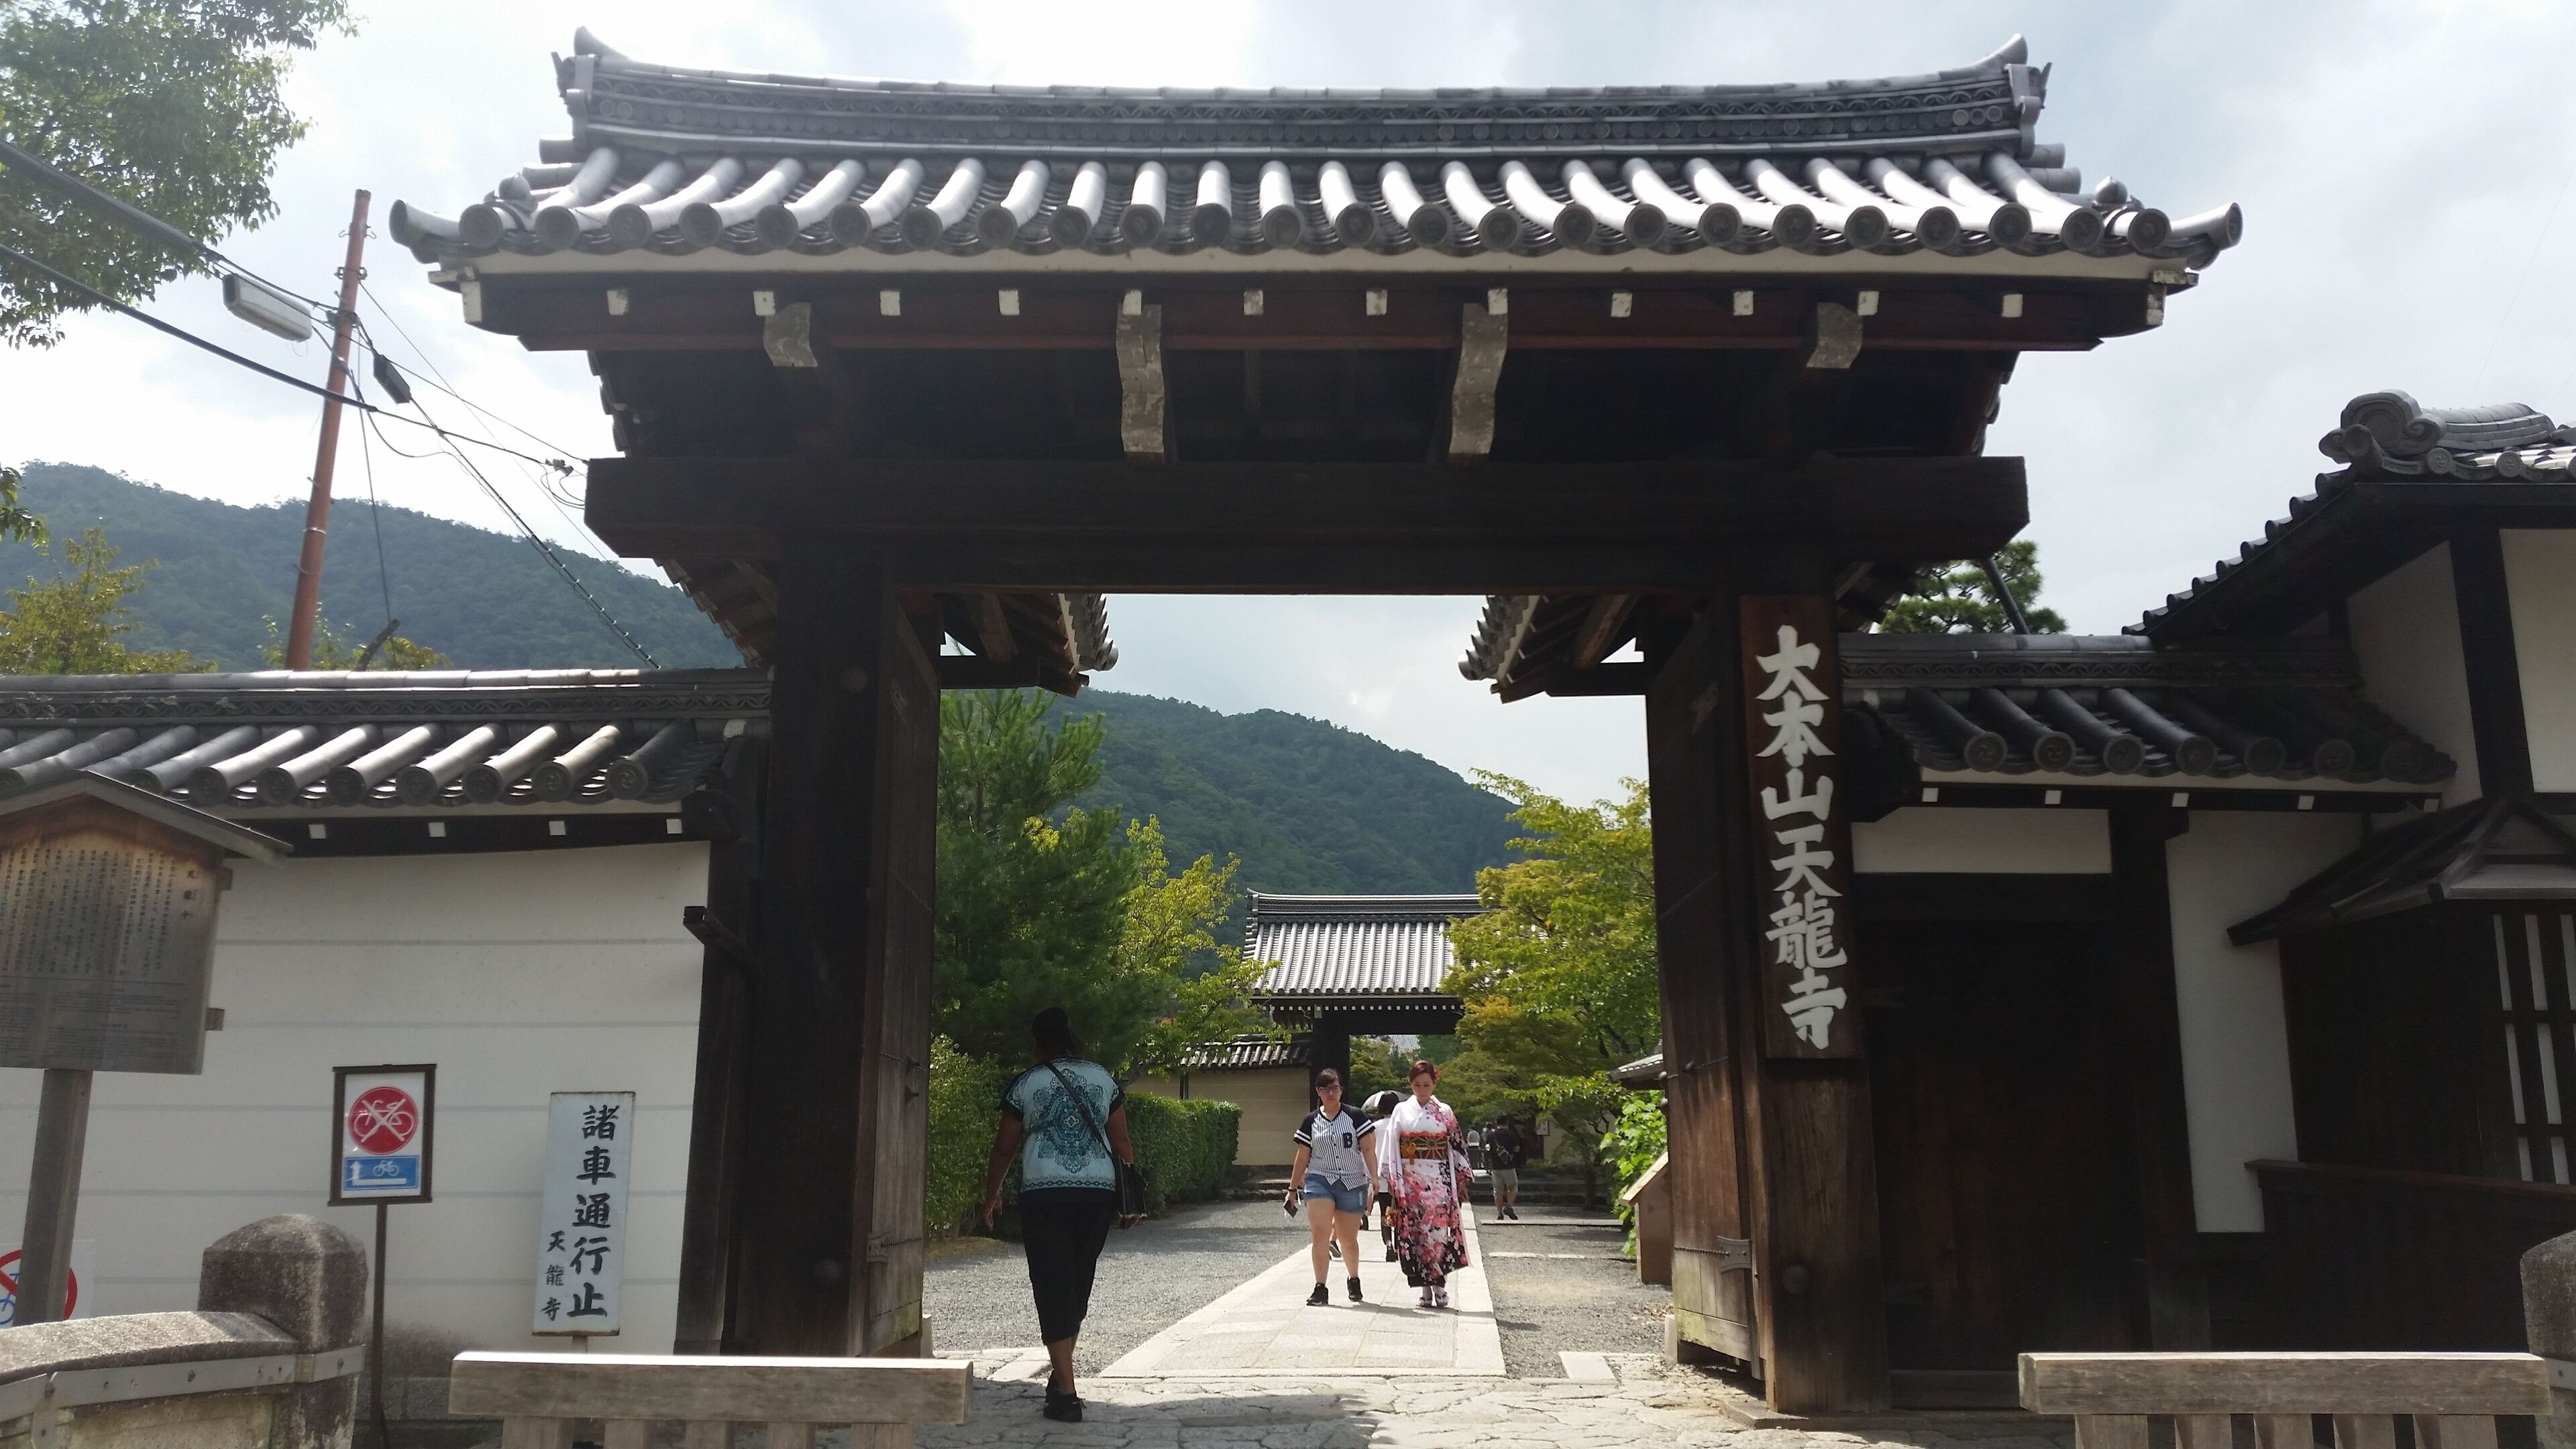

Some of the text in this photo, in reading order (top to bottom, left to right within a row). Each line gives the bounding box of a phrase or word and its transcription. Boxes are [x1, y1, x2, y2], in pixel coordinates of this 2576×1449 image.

[1756, 625, 1847, 1050] 大本山天龍寺
[566, 1104, 621, 1318] 諸車通行止
[1342, 1132, 1352, 1148] B
[541, 1230, 566, 1322] 天龍寺
